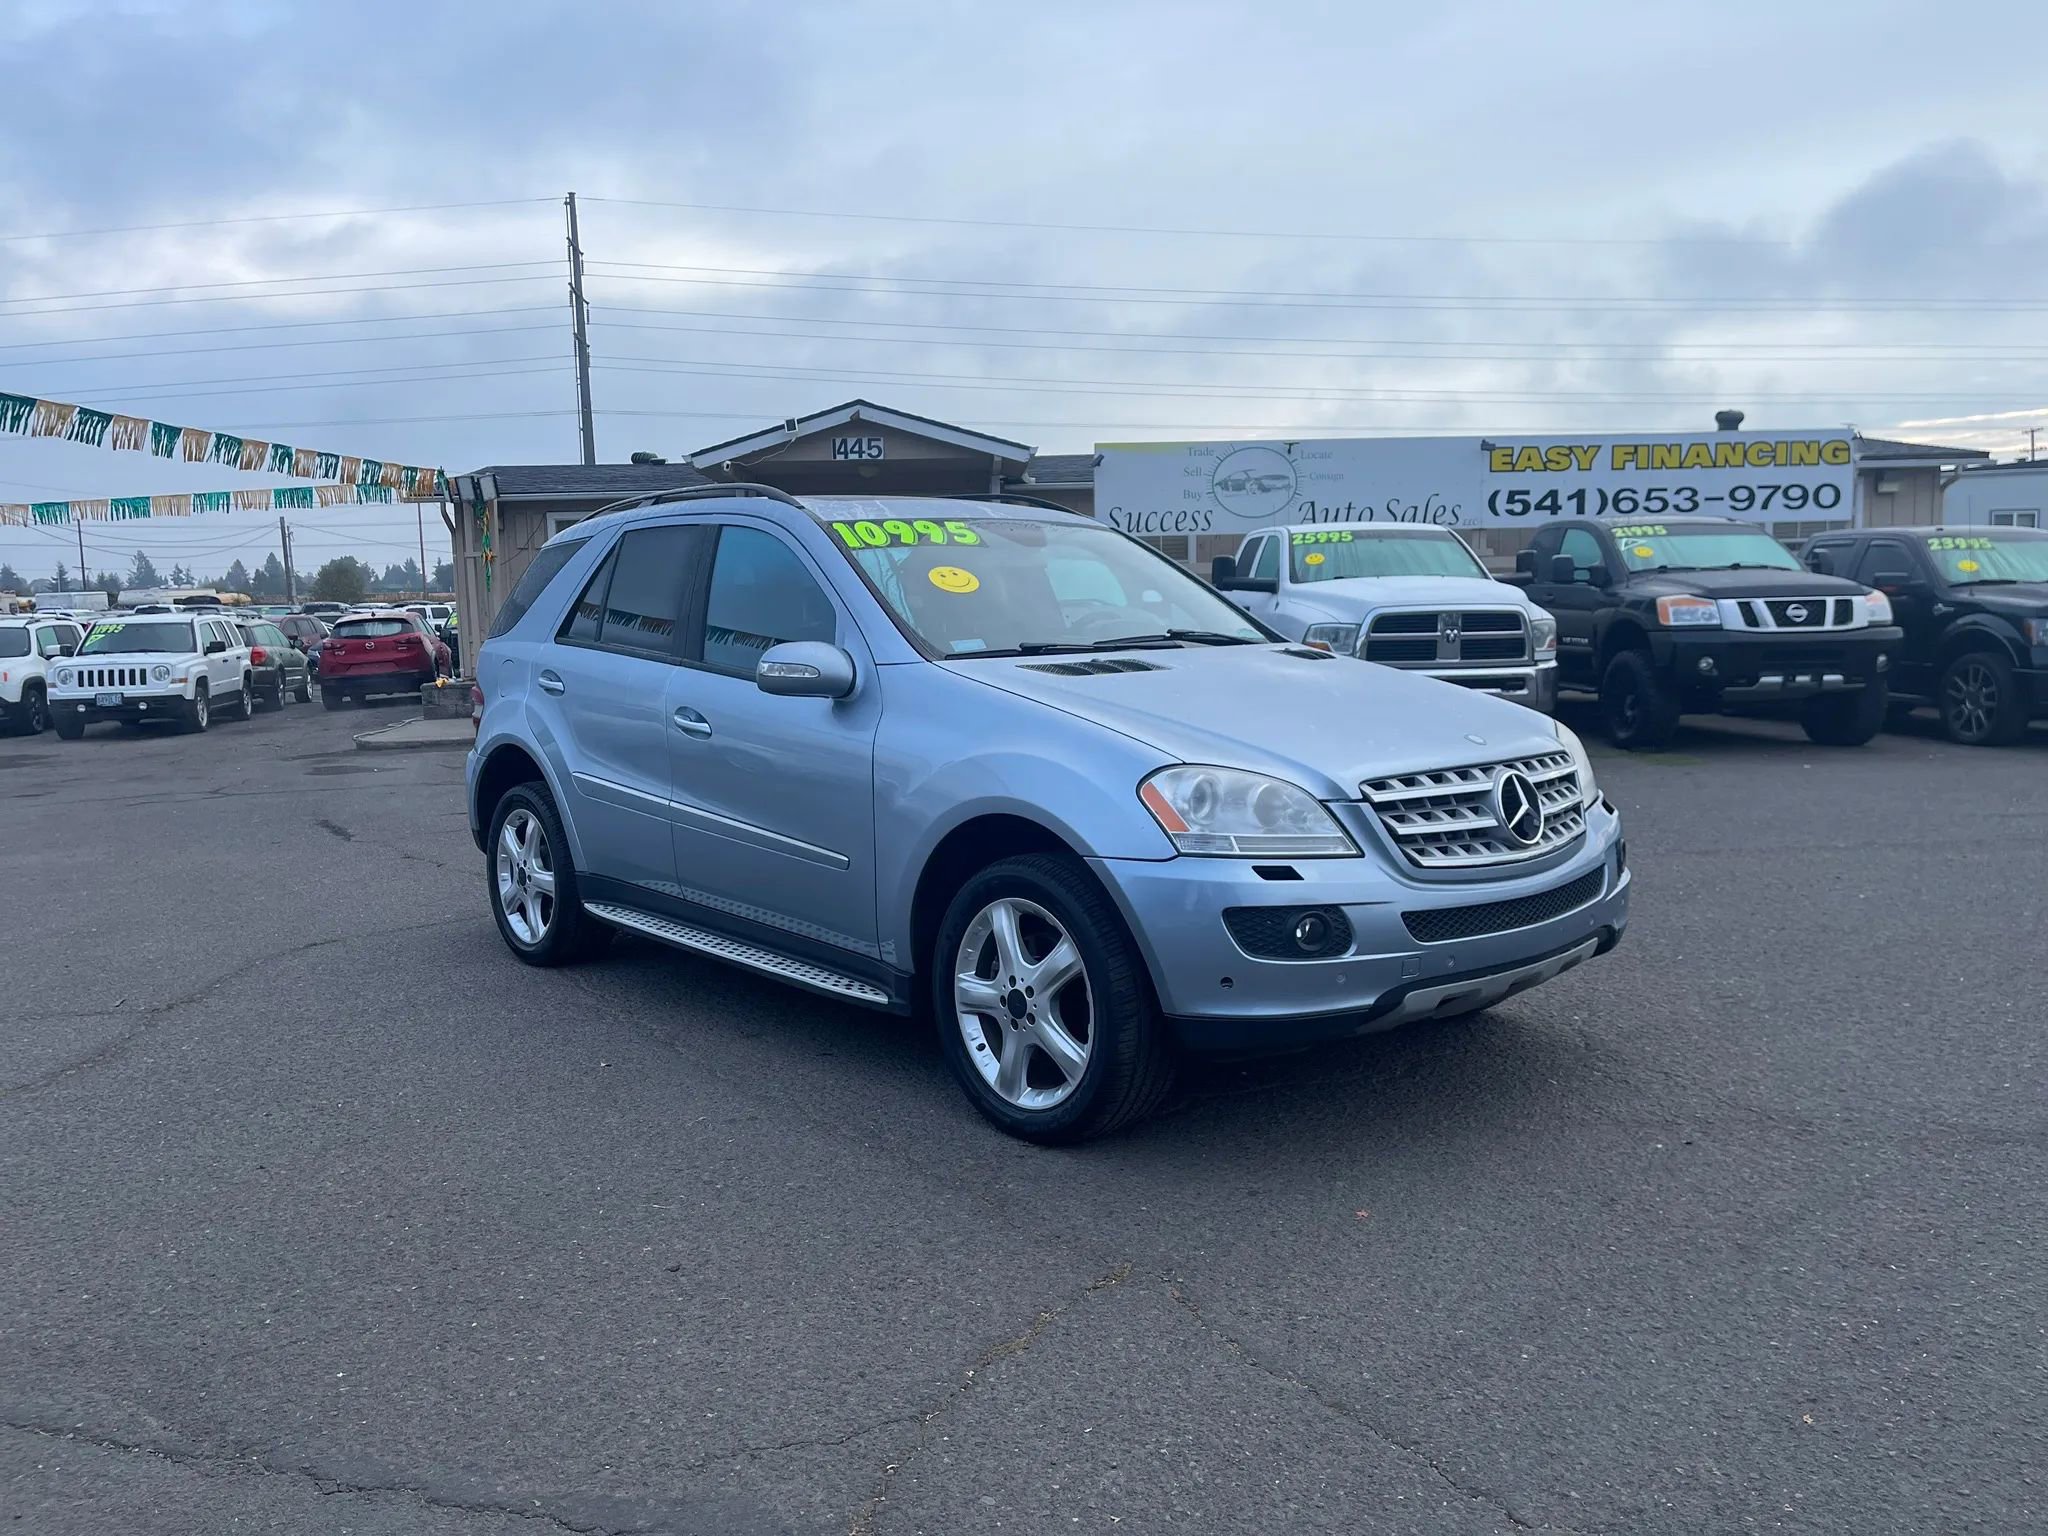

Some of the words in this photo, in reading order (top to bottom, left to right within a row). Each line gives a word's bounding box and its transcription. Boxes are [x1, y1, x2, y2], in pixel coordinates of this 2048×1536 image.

[832, 438, 884, 459] 1445
[1186, 447, 1215, 457] Trade
[1489, 445, 1603, 472] EASY
[1611, 439, 1851, 471] FINANCING
[1183, 466, 1202, 477] Sell
[1183, 489, 1201, 502] Buy
[1487, 483, 1842, 517] (541)653-9790
[1109, 506, 1214, 533] Success
[1298, 499, 1375, 524] Auto
[1386, 493, 1462, 527] Sales
[832, 519, 981, 549] 10995
[1292, 531, 1353, 545] 25995
[1611, 525, 1668, 538] 21995
